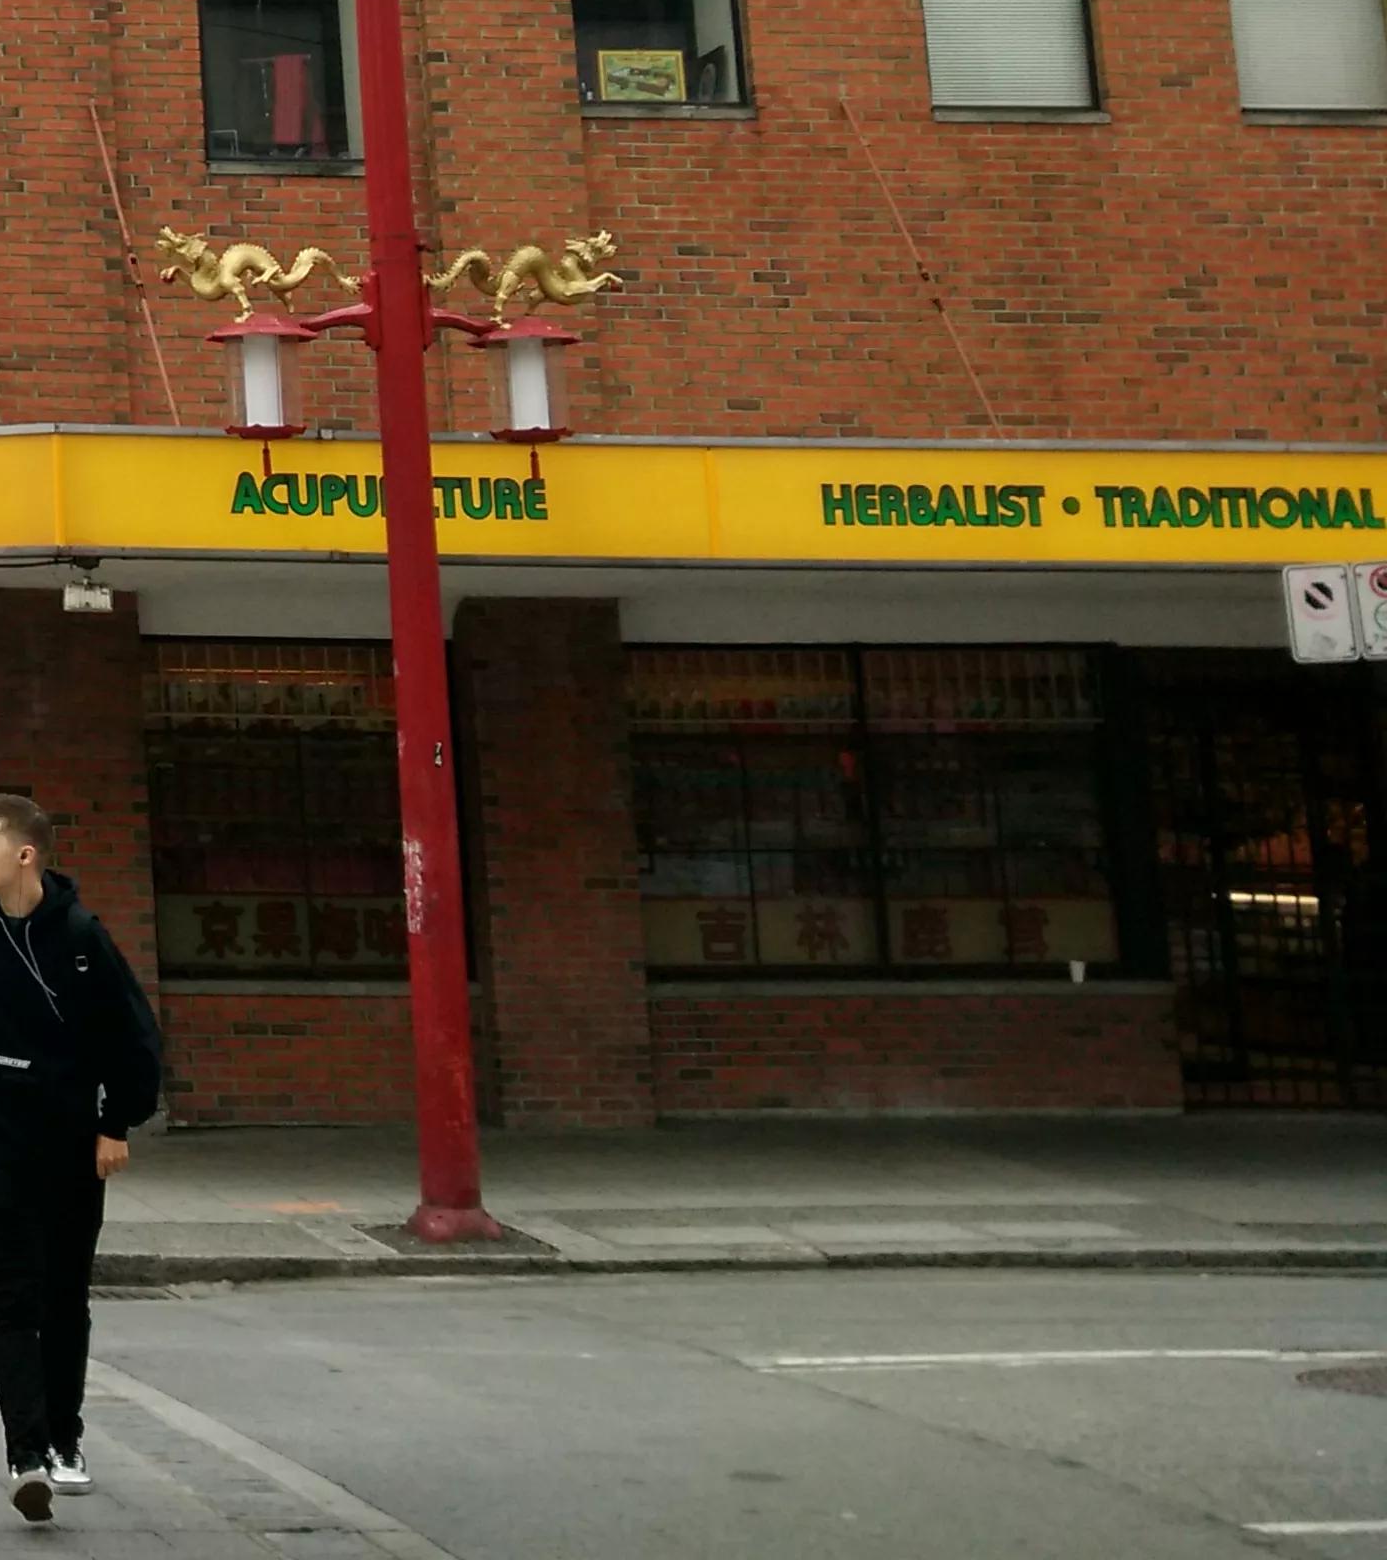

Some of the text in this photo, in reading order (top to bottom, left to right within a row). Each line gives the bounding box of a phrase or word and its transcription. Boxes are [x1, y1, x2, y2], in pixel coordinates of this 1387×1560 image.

[231, 472, 548, 520] ACUPUTURE
[821, 483, 1386, 530] HERBALIST TRADITIONAL
